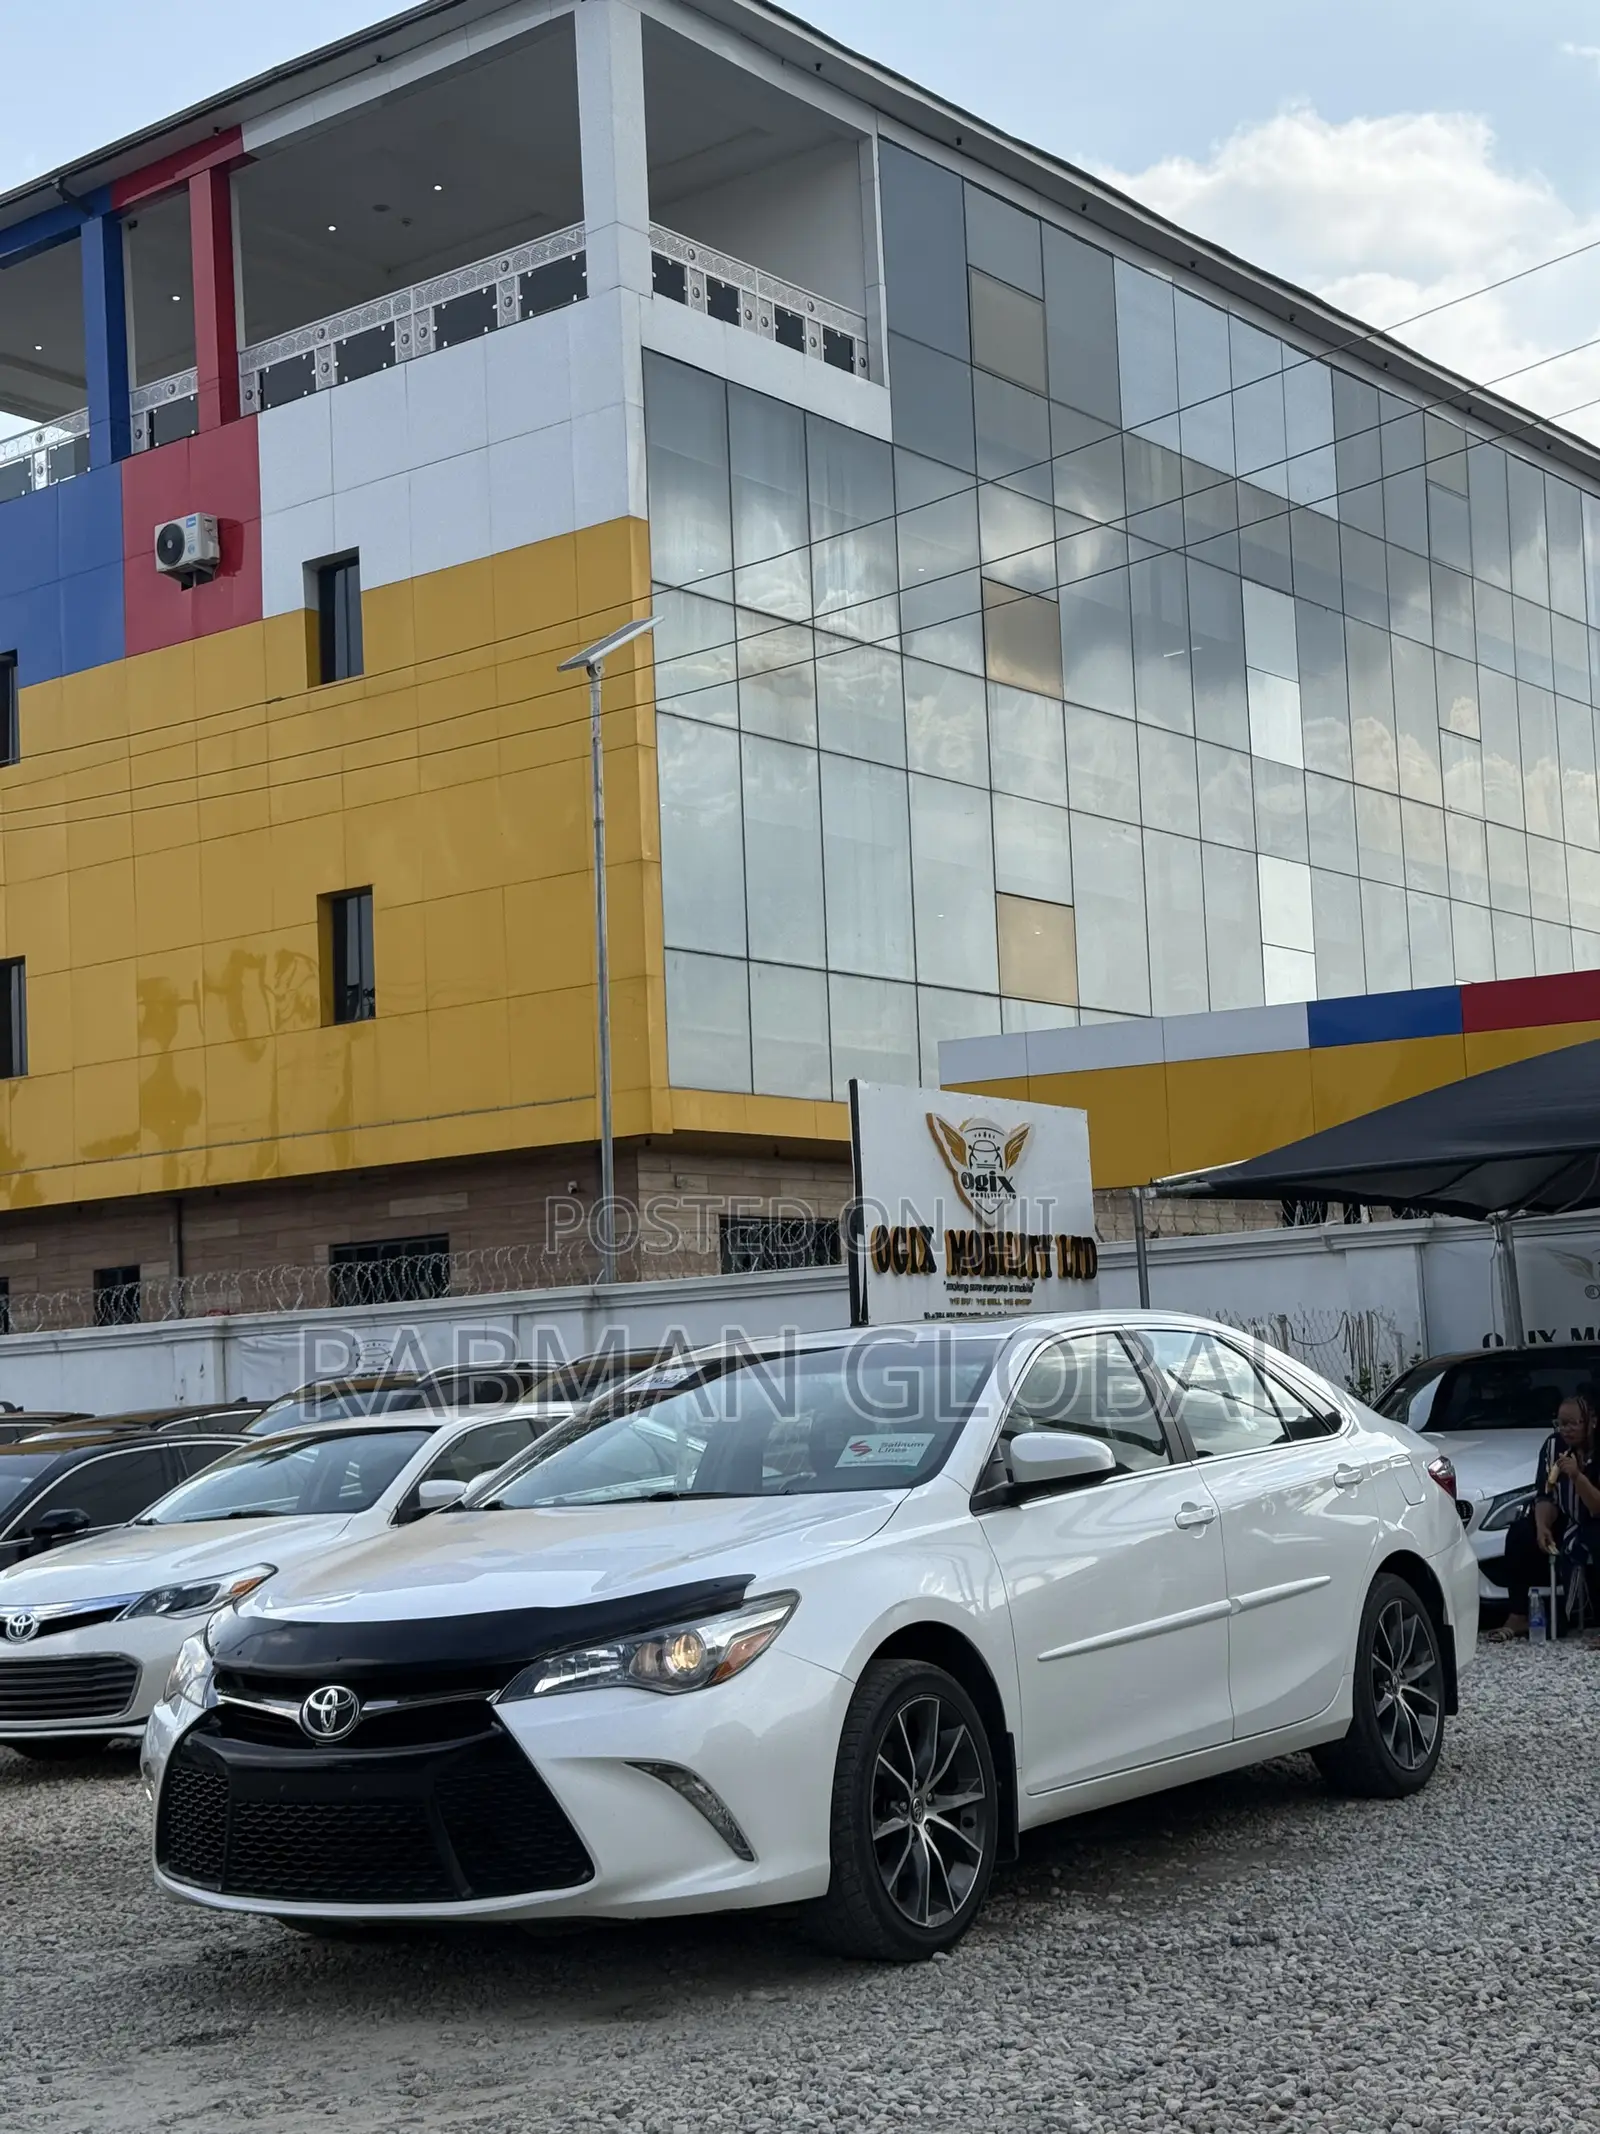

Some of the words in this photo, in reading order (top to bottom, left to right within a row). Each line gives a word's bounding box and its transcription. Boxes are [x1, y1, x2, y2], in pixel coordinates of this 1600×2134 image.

[871, 1224, 937, 1275] OGIX
[944, 1229, 1053, 1280] MOBILITY
[1056, 1234, 1098, 1280] LTD
